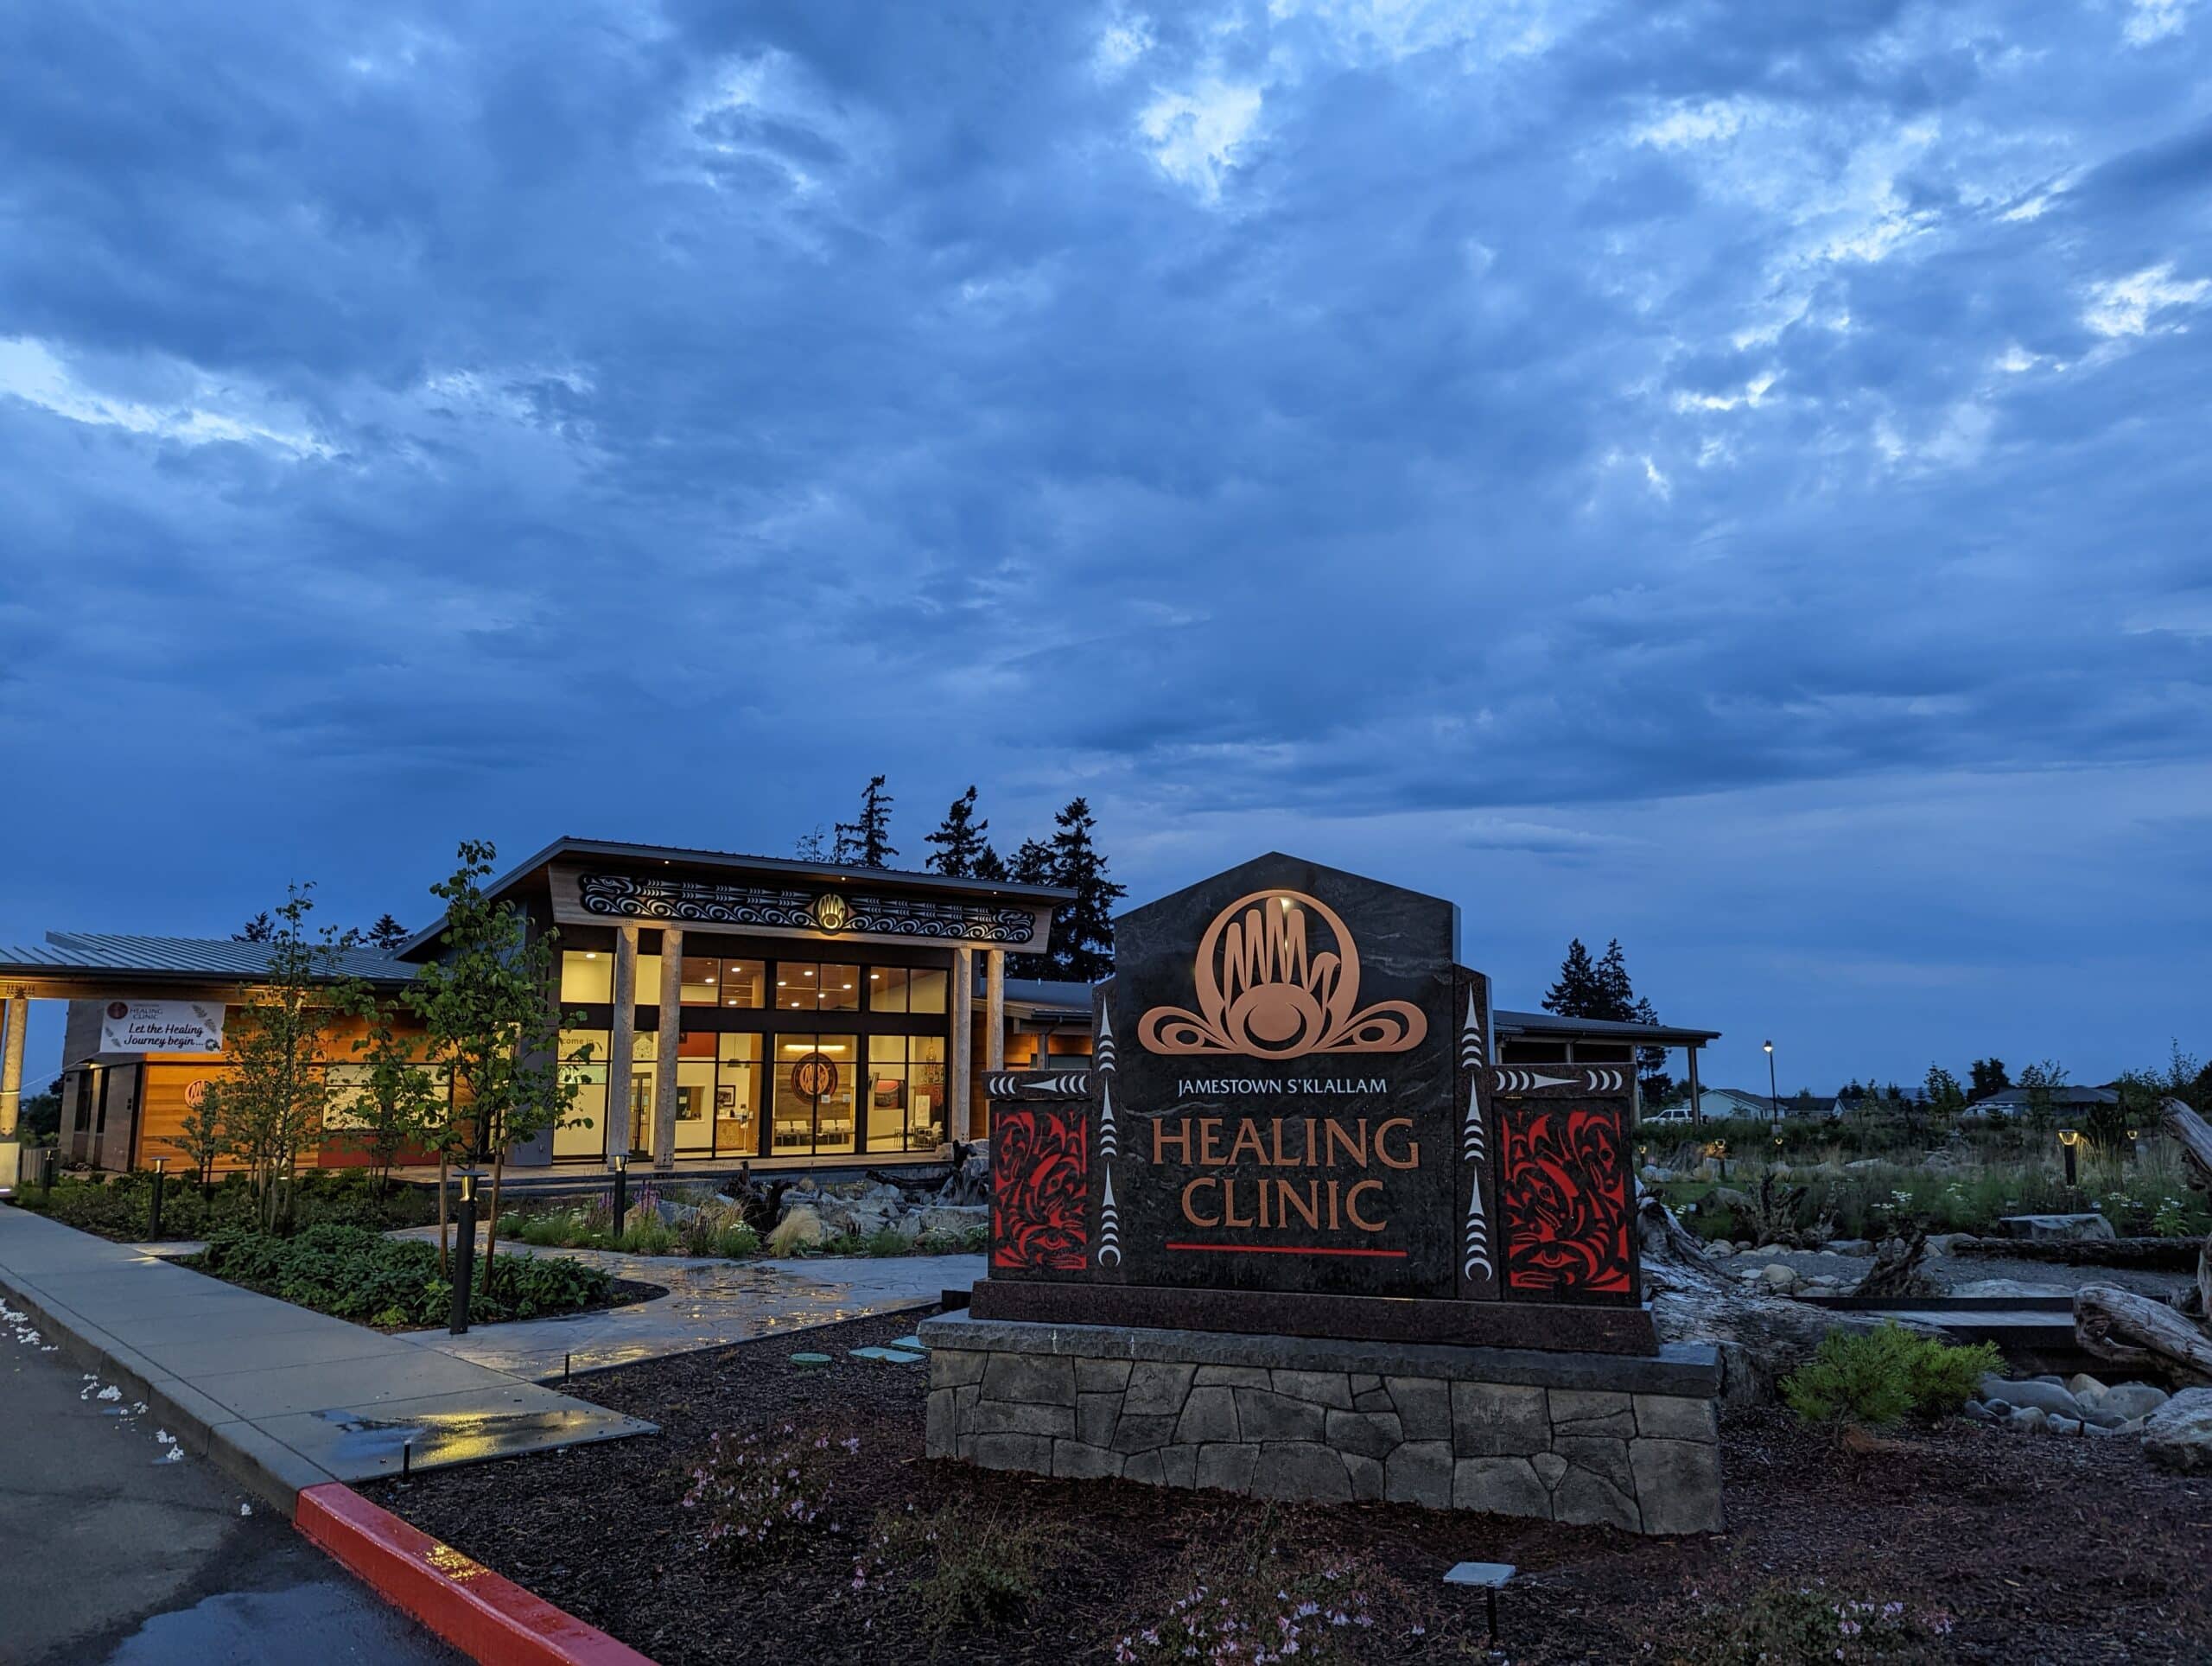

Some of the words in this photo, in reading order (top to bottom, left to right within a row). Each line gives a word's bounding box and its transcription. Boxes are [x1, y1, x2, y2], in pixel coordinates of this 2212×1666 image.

[129, 1023, 146, 1033] Let
[147, 1023, 164, 1033] the
[165, 1023, 204, 1038] Healing
[124, 1035, 167, 1048] Journey
[1178, 1079, 1282, 1097] JAMESTOWN
[1287, 1078, 1388, 1094] S'KLALLAM
[1151, 1117, 1420, 1170] HEALING
[1181, 1177, 1388, 1232] CLINIC
